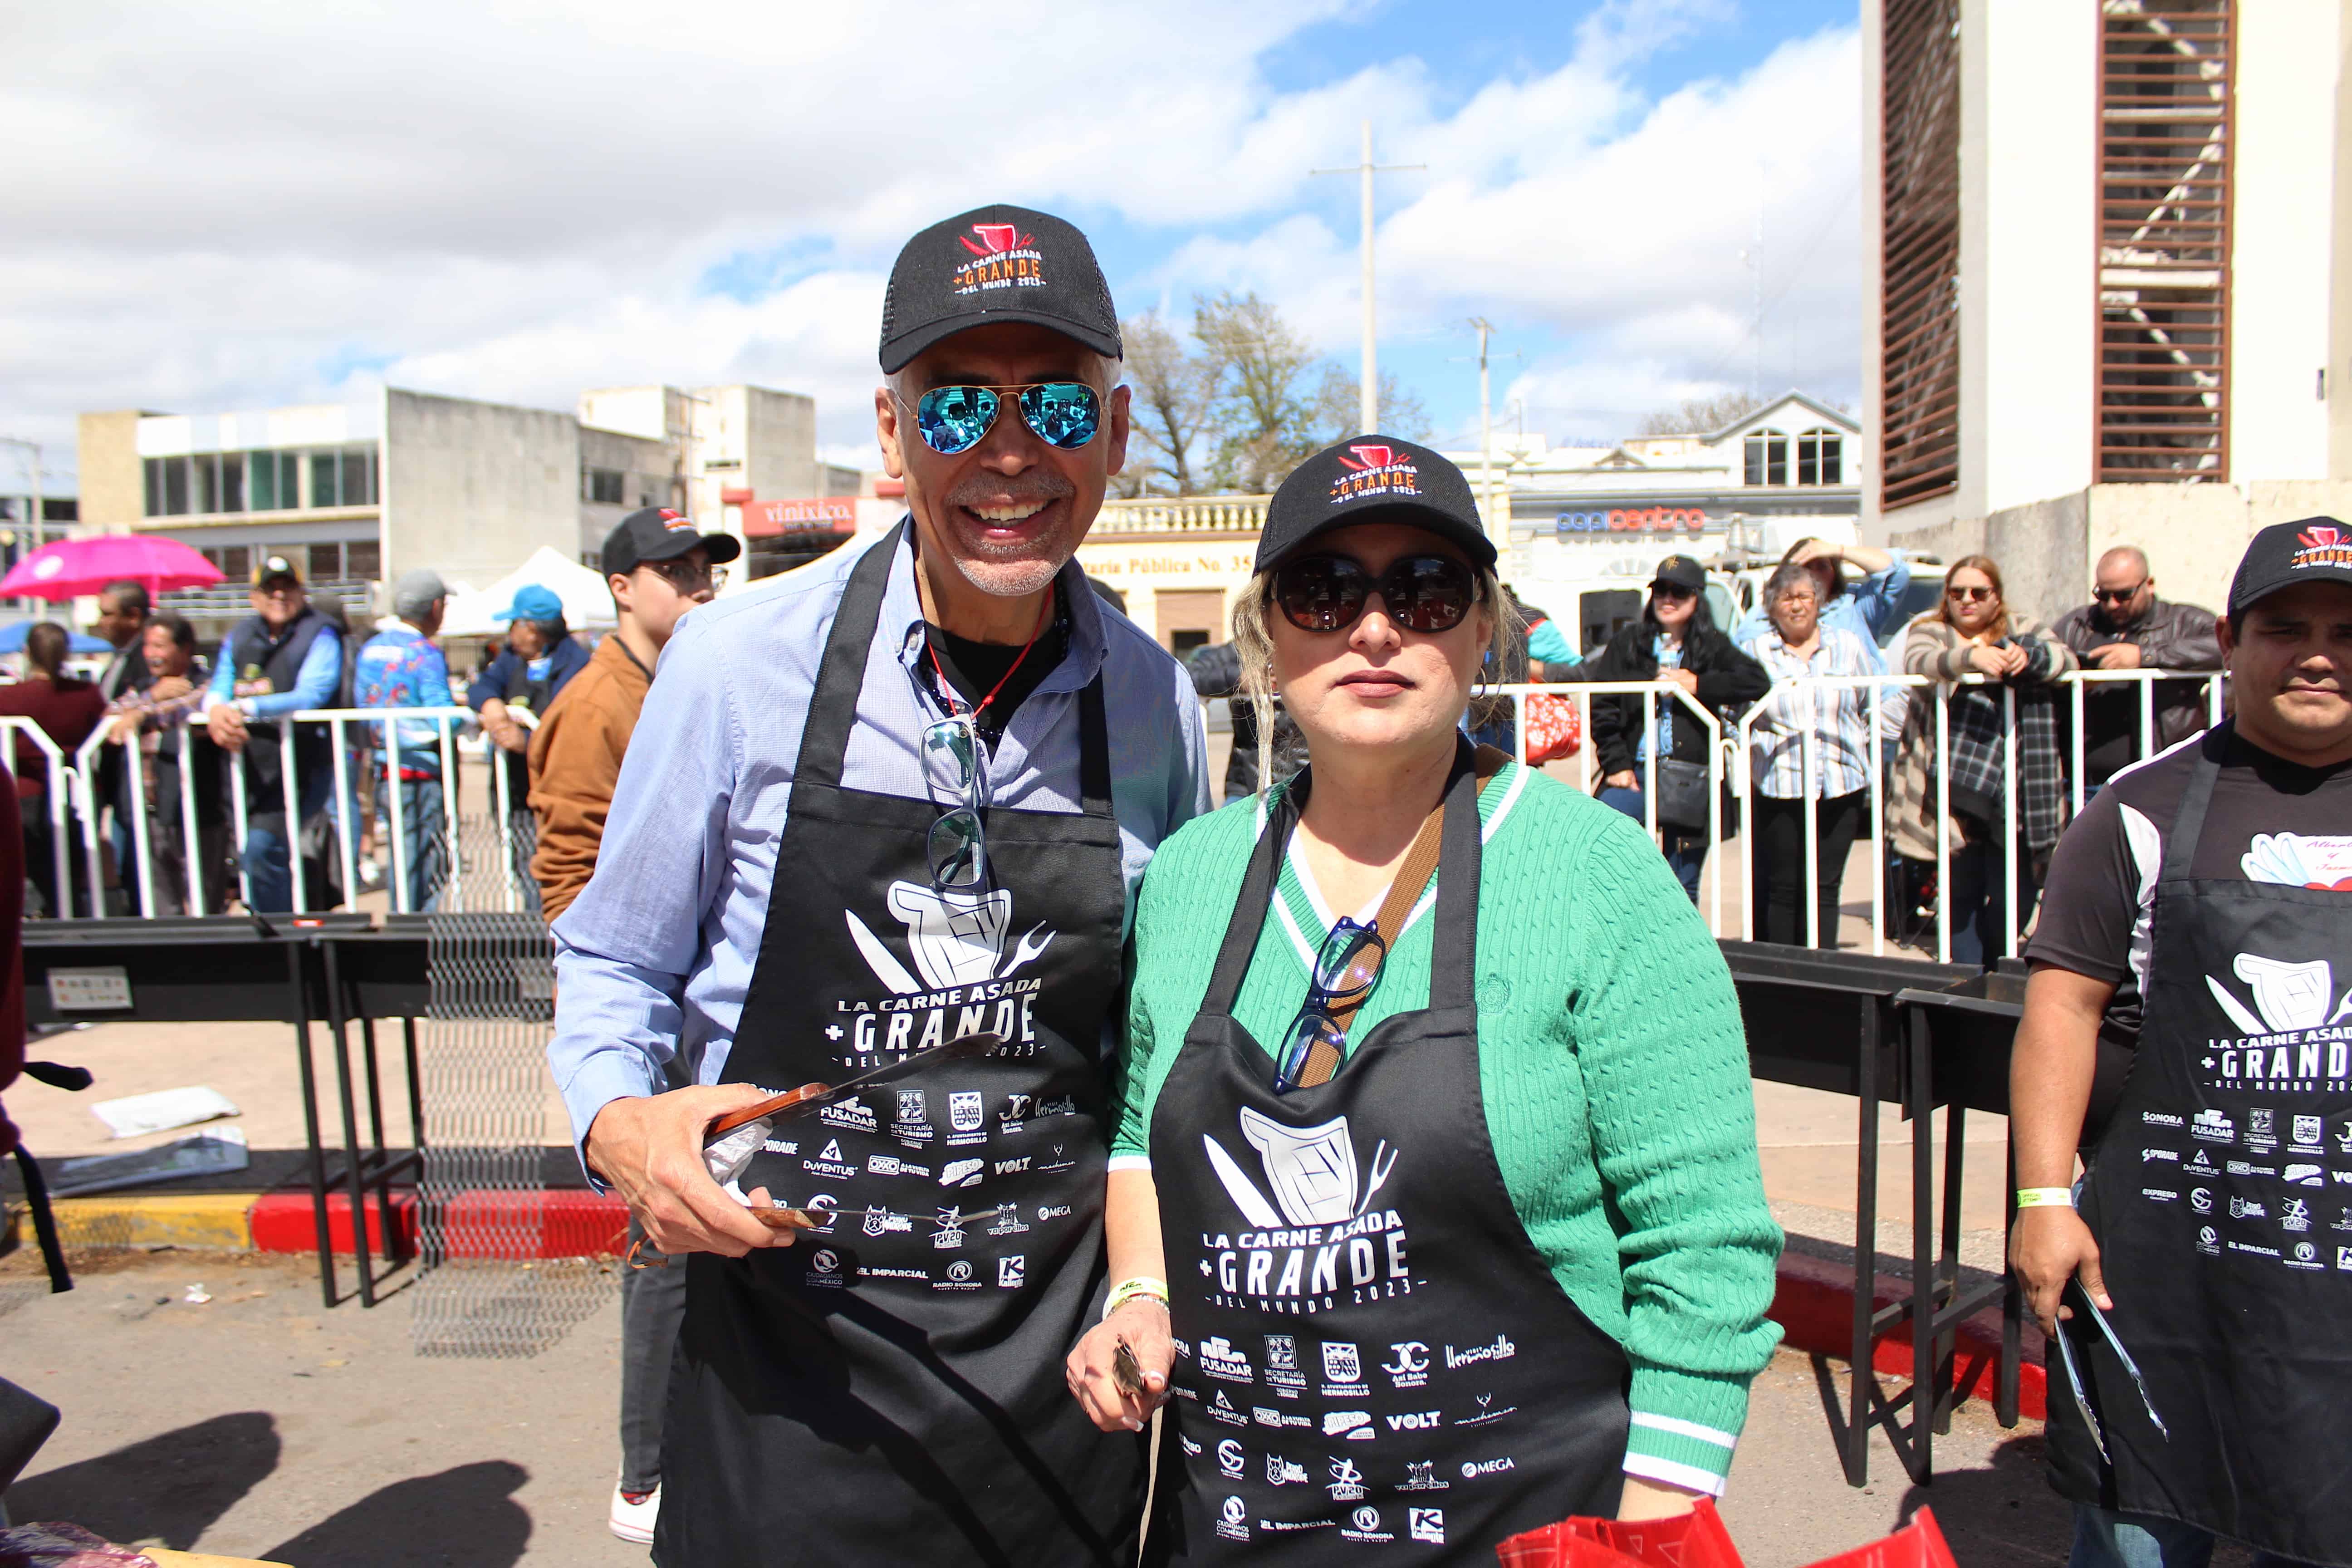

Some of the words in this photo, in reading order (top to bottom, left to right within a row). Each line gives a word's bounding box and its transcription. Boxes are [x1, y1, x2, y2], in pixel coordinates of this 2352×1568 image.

[957, 262, 970, 274] LA
[972, 252, 1007, 268] CARNE
[1009, 249, 1042, 260] ASADA
[1335, 475, 1347, 485] LA
[1349, 466, 1382, 481] CARNE
[1384, 464, 1418, 474] ASADA
[1557, 506, 1705, 533] copicentro
[838, 1000, 871, 1012] LA
[878, 990, 961, 1012] CARNE
[969, 977, 1042, 1002] ASADA
[2208, 1039, 2232, 1049] LA
[2236, 1032, 2299, 1049] CARNE
[2255, 1081, 2312, 1091] MUNDO
[820, 1107, 877, 1128] FUSADAR
[2142, 1111, 2184, 1125] SONORA
[898, 1130, 933, 1138] TURISMO
[2191, 1124, 2234, 1138] FUSADAR
[946, 1137, 988, 1146] HERMOSILLO
[2249, 1137, 2277, 1145] TURISMO
[870, 1160, 898, 1171] OXXO
[2228, 1163, 2248, 1172] OXXO
[1202, 1232, 1230, 1249] LA
[1238, 1228, 1323, 1249] CARNE
[1328, 1209, 1404, 1244] ASADA
[2238, 1243, 2281, 1256] IMPARCIAL
[872, 1268, 929, 1279] IMPARCIAL
[1261, 1296, 1333, 1315] MUNDO
[1445, 1333, 1515, 1369] Hermosillo
[1492, 1351, 1515, 1361] TURISMO
[1200, 1356, 1253, 1377] FUSADAR
[1264, 1368, 1306, 1379] SECRETARÍA
[1272, 1377, 1307, 1386] TURISMO
[1255, 1411, 1279, 1423] OXXO
[1216, 1519, 1249, 1533] CIUDADANOS
[1275, 1519, 1336, 1530] IMPARCIAL
[1341, 1529, 1362, 1539] RADIO
[1363, 1531, 1394, 1540] SONORA
